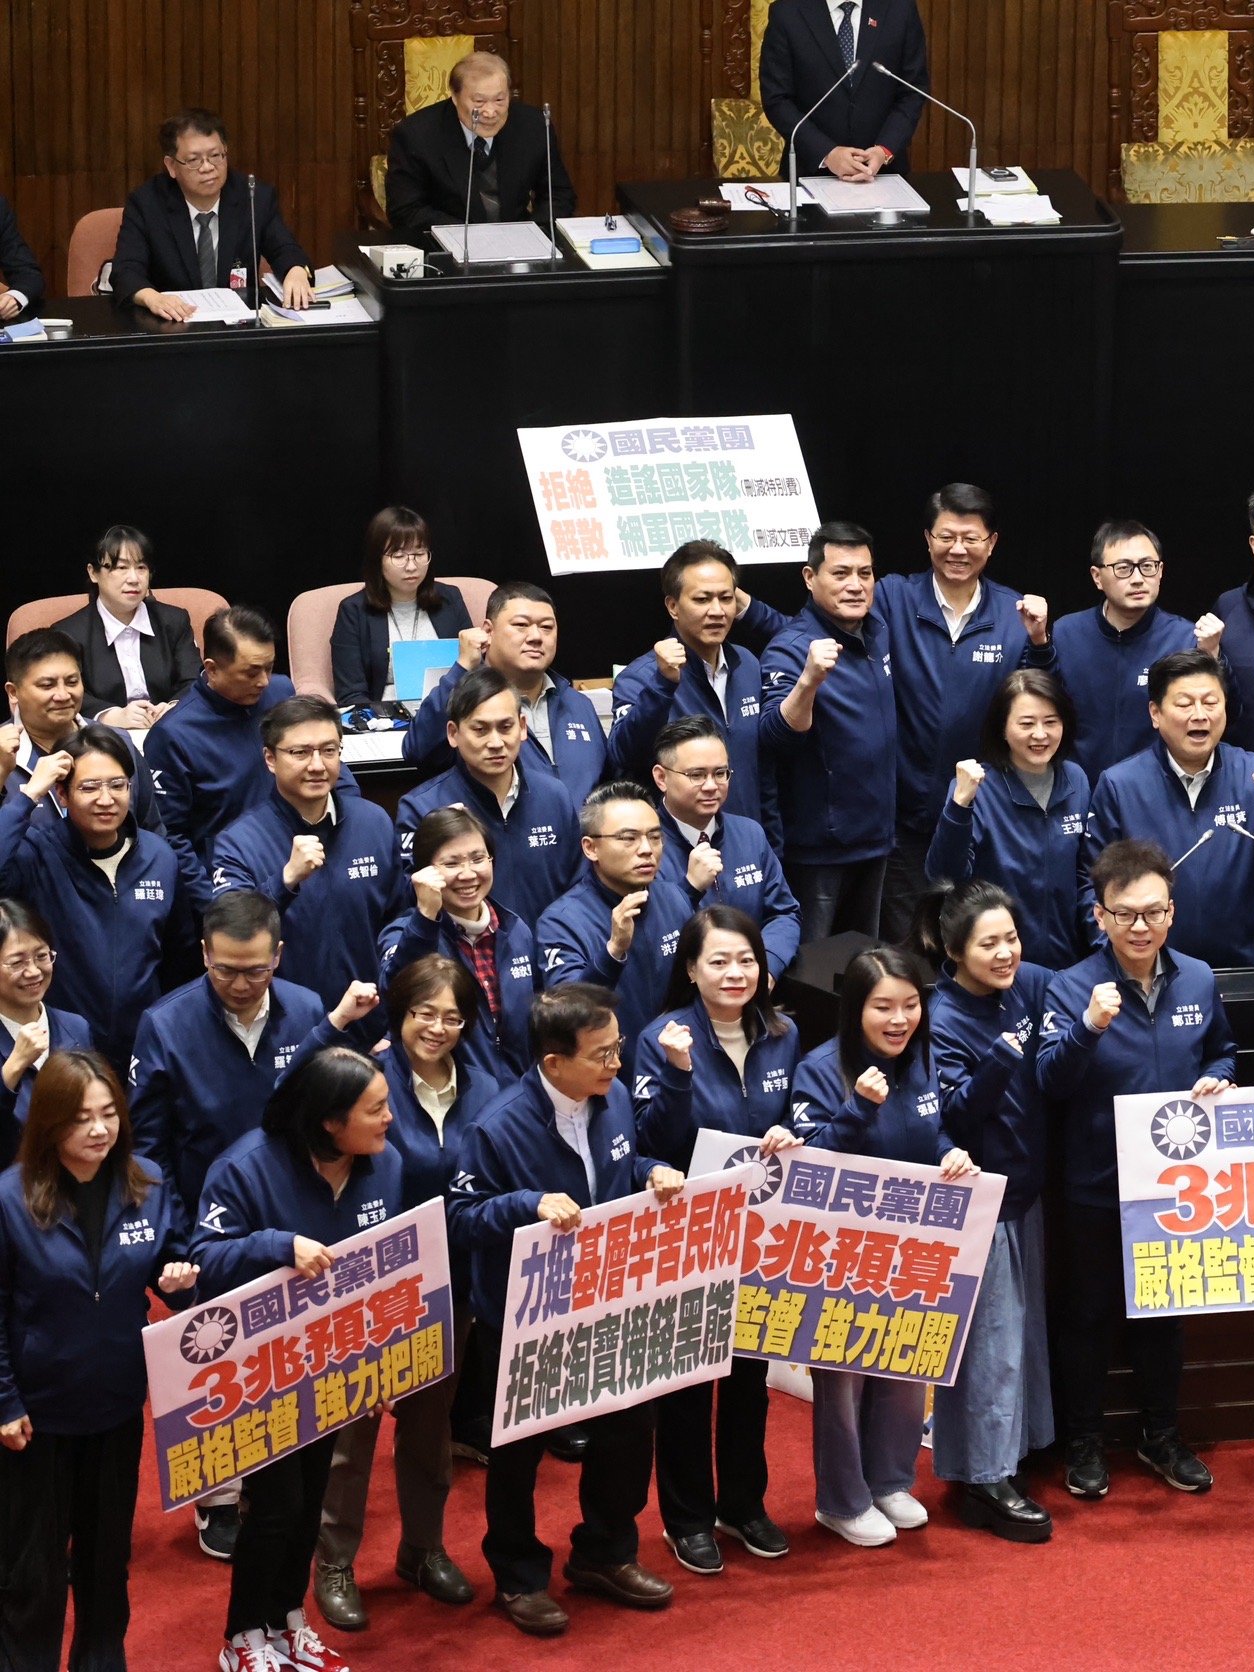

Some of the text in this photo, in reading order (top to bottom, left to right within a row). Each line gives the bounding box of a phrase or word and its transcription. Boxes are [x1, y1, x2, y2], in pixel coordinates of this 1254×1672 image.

[608, 424, 755, 456] 國民黨團
[539, 468, 597, 511] 拒絕
[604, 460, 740, 506] 造謠國家隊
[550, 518, 608, 560] 解散
[616, 508, 752, 557] 網軍國家隊
[528, 834, 557, 848] 葉元之
[348, 864, 378, 880] 張智倫
[781, 1159, 973, 1230] 國民黨團
[118, 1228, 155, 1245] 馬文君
[515, 1183, 746, 1329] 力挺基層辛苦民防
[240, 1223, 419, 1340] 國民黨團
[187, 1274, 428, 1427] 3兆預算
[734, 1284, 960, 1378] 監督 強力把關
[166, 1321, 444, 1500] 嚴格監督 強力把關
